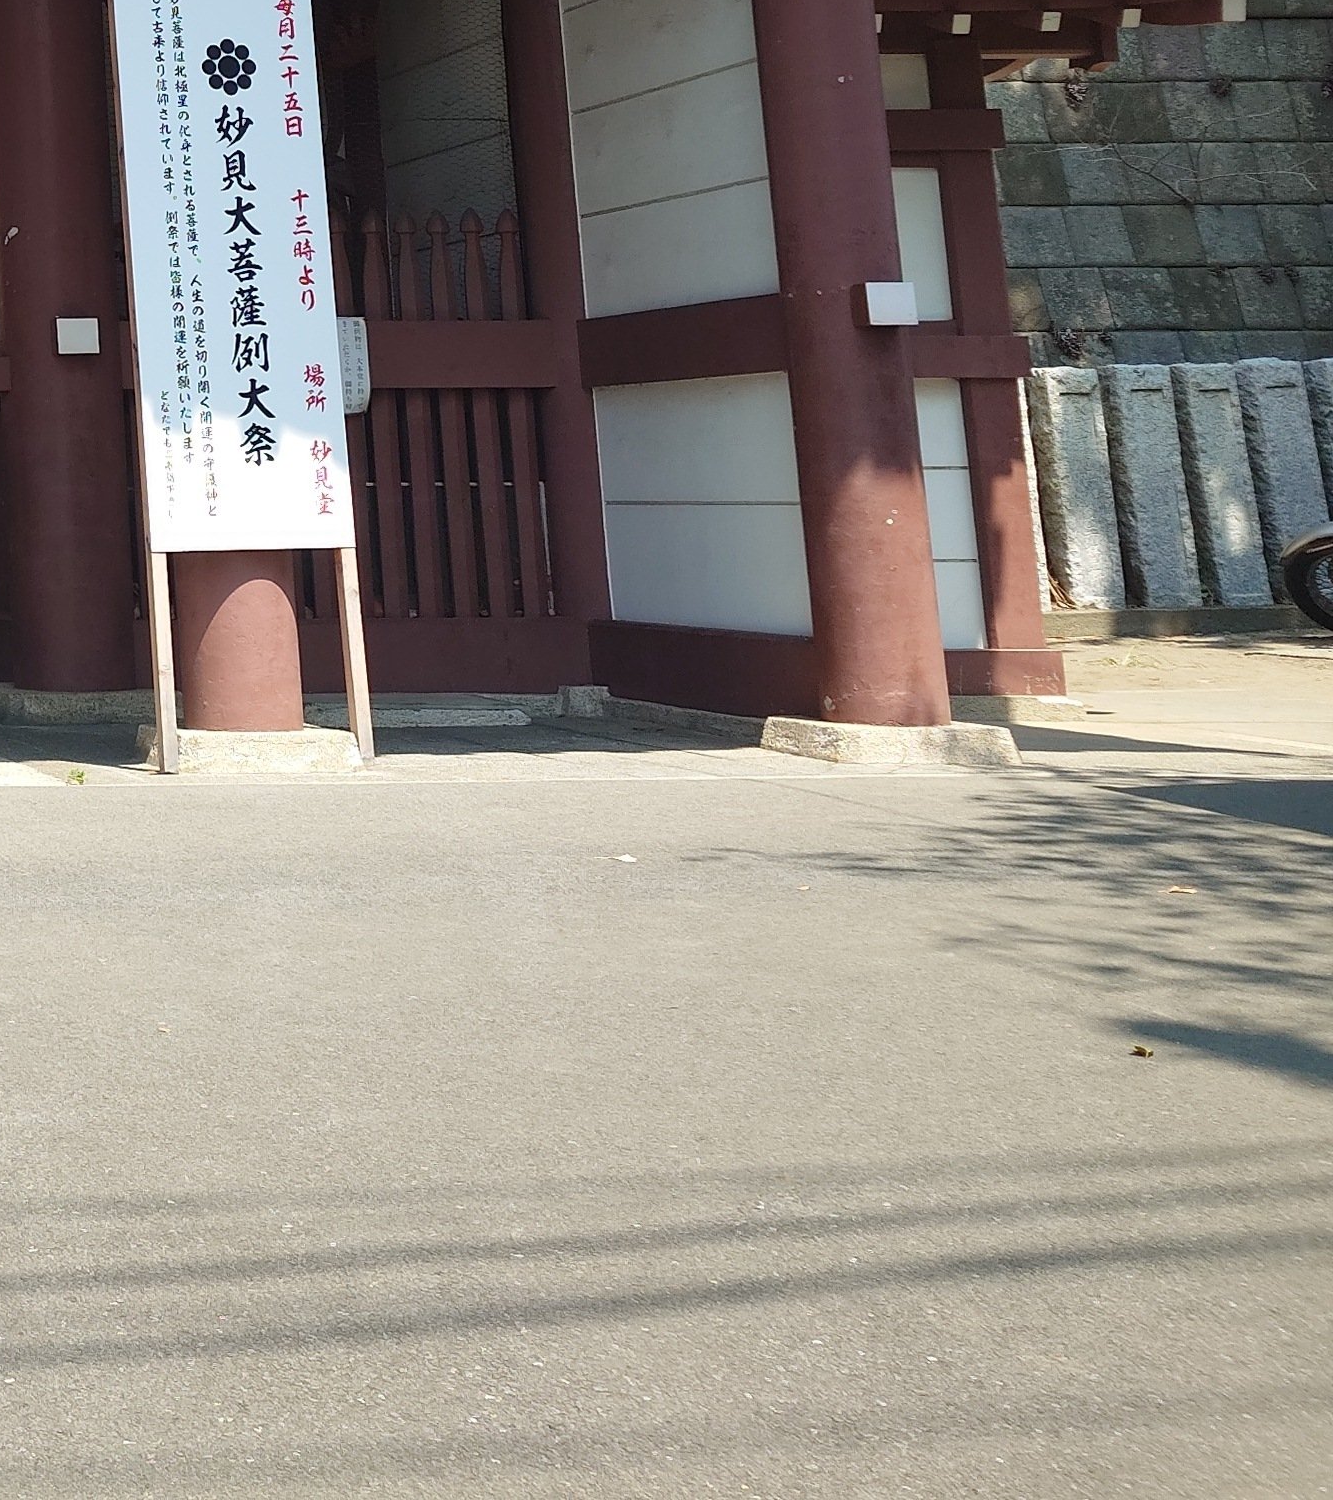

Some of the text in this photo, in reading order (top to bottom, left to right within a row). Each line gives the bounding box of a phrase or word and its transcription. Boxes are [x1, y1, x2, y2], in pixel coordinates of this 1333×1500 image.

[213, 104, 279, 467] 妙見大菩薩例大祭
[288, 189, 317, 312] 十三時より
[304, 364, 327, 413] 場所
[310, 440, 335, 516] 妙見堂
